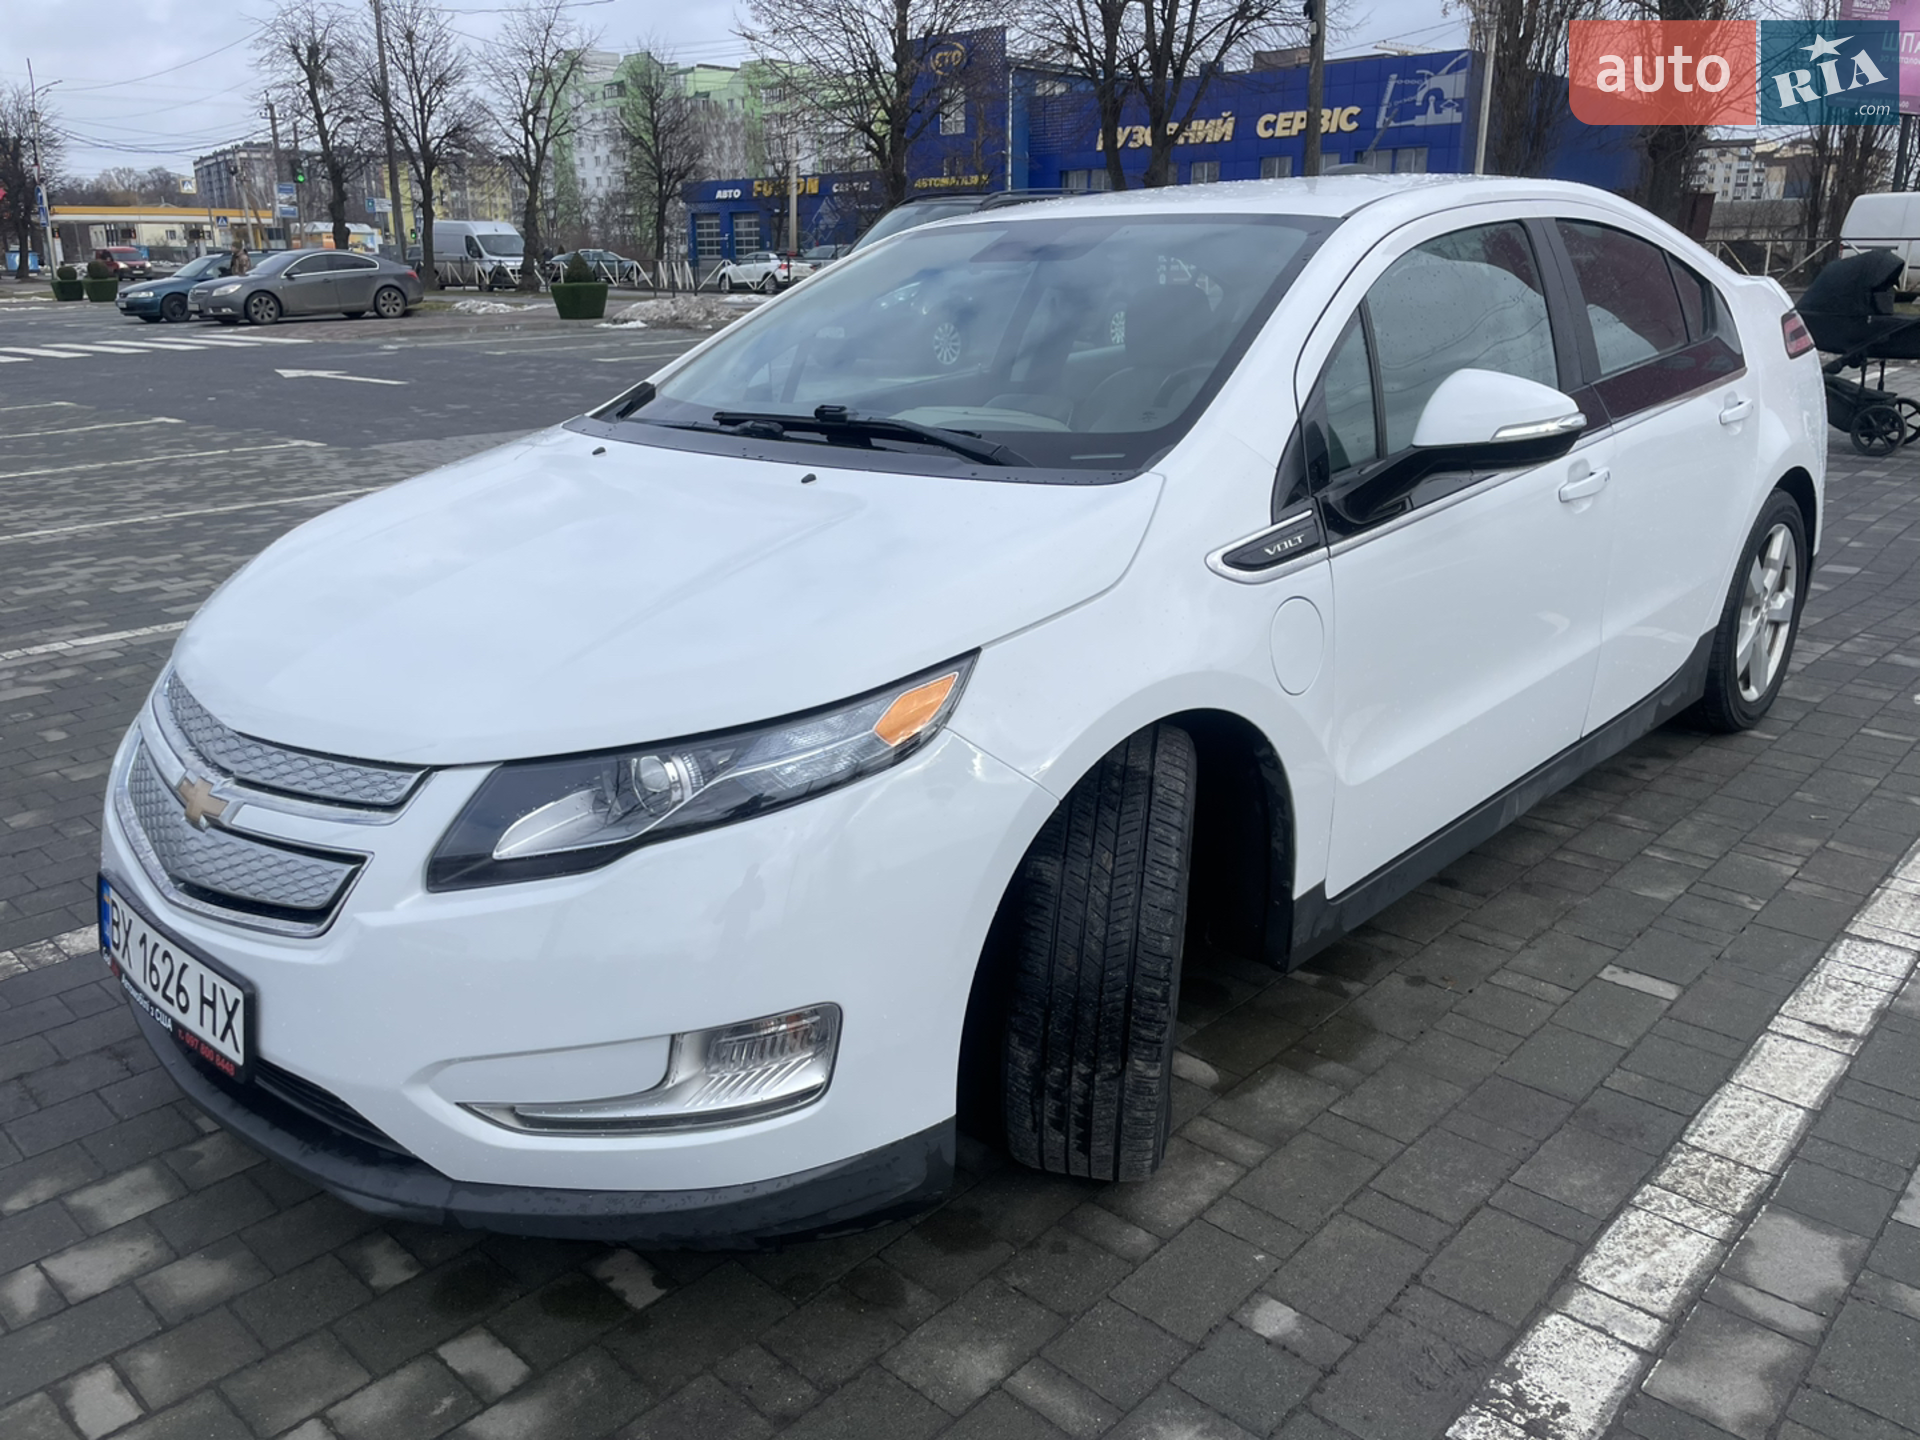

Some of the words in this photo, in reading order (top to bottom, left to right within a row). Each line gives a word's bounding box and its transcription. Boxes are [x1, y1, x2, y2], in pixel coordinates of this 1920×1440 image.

[1256, 106, 1361, 138] СЕРВІС
[715, 188, 742, 199] АВТО
[1264, 534, 1304, 555] VOLT
[110, 898, 133, 969] BX
[139, 932, 190, 1015] 1626
[199, 972, 241, 1054] HX
[154, 1008, 173, 1032] США
